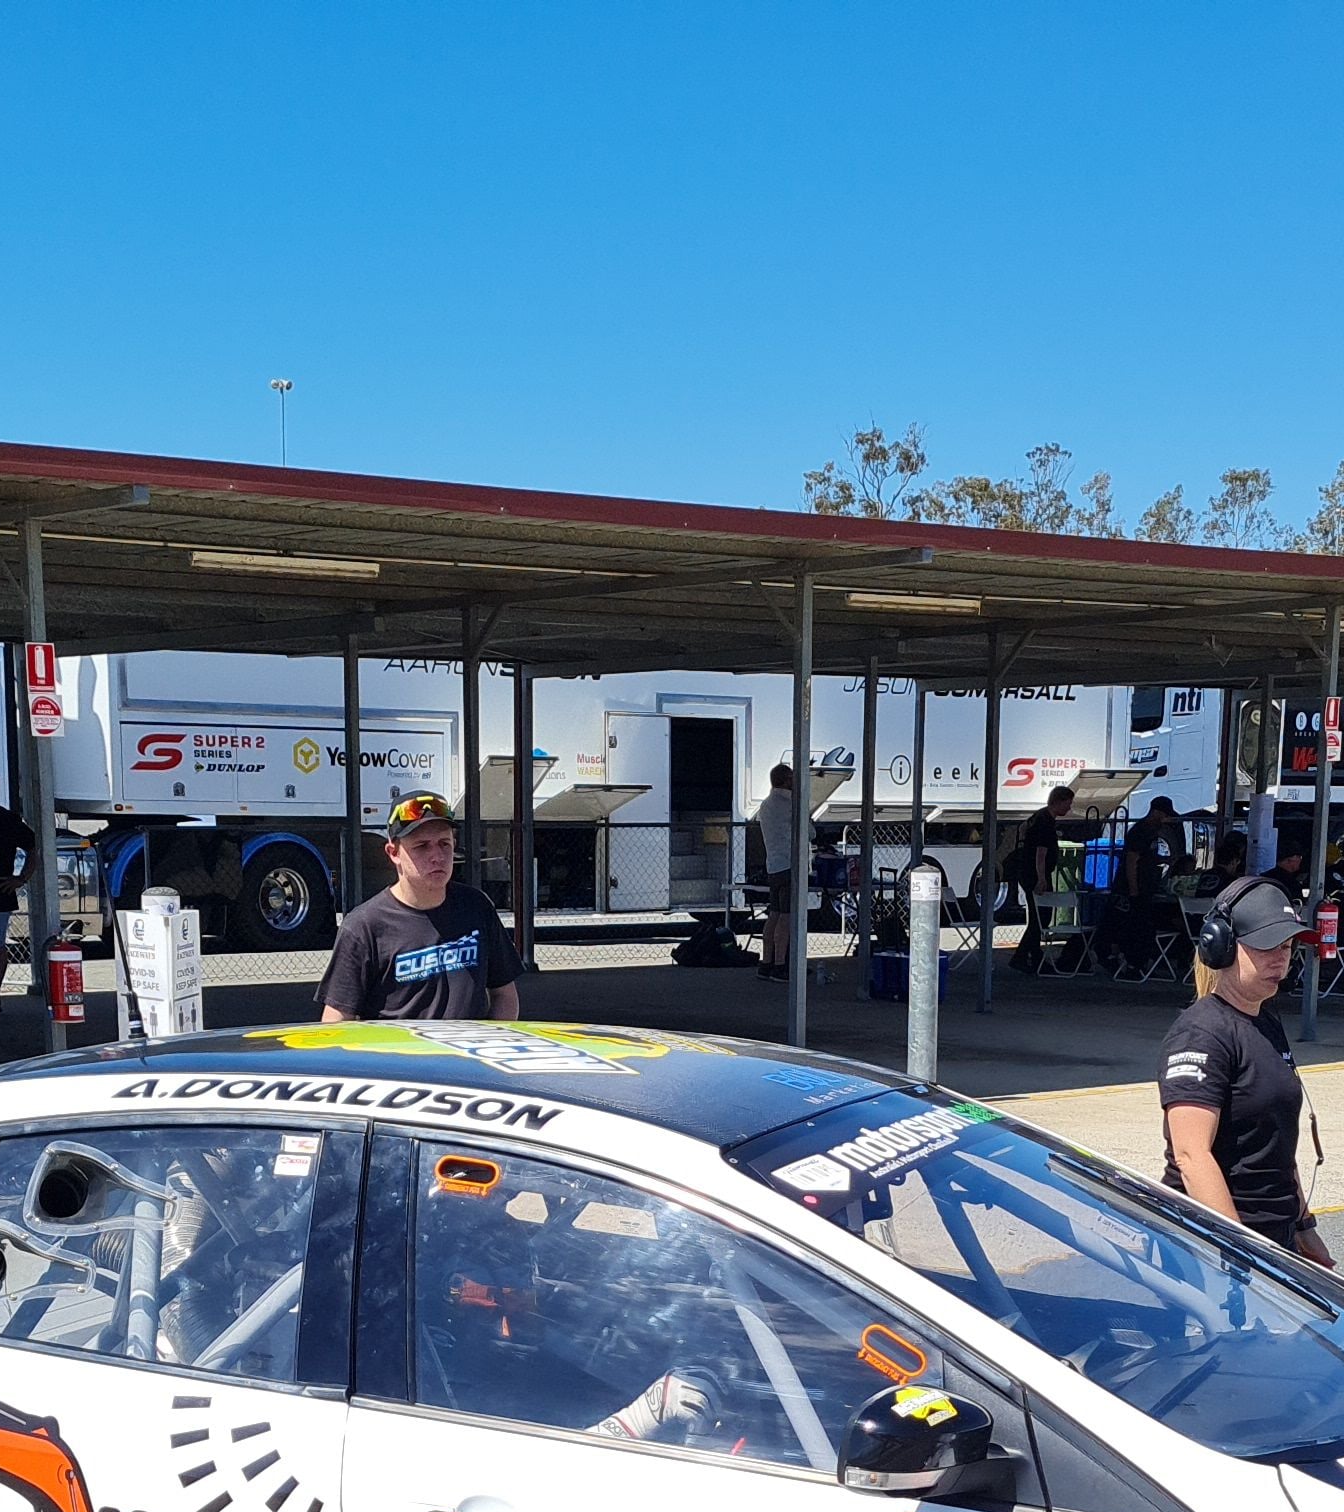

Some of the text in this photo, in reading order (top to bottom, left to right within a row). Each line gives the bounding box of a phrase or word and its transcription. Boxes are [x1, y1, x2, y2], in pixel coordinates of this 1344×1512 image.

[1172, 688, 1202, 713] nti
[193, 735, 265, 749] SUPER 2
[194, 750, 233, 759] SERIES
[326, 746, 434, 769] YeowCover
[206, 763, 265, 773] DUNLOP
[1041, 759, 1086, 769] SUPER 3
[129, 970, 156, 978] OVID-19
[143, 981, 160, 991] SAFE
[111, 1078, 565, 1131] A.DONALDSON
[827, 1104, 979, 1171] motorsport
